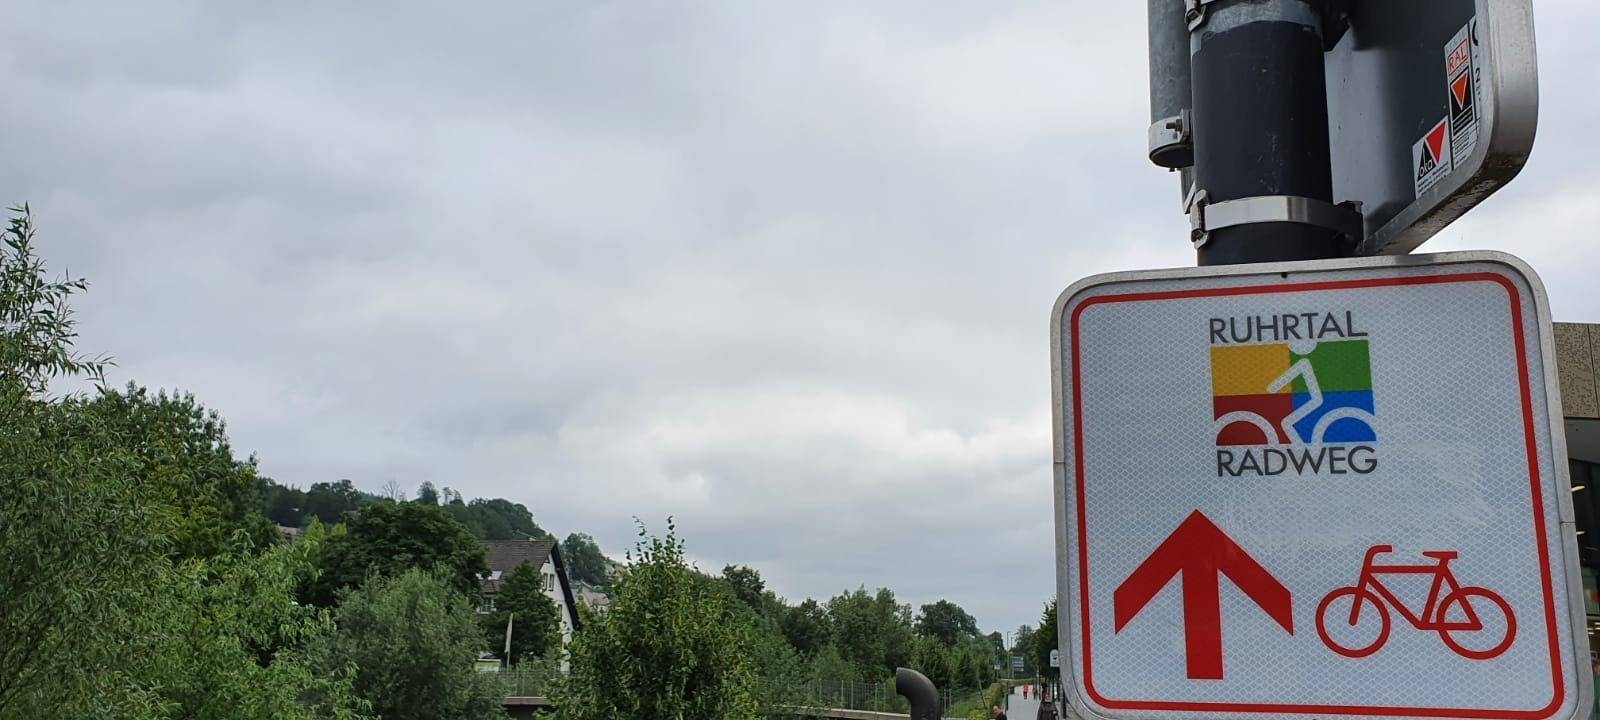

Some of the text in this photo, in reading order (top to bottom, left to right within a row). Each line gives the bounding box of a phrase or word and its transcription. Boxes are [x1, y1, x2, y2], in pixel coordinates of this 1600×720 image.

[1448, 45, 1467, 72] RAL
[1209, 311, 1368, 344] RUHRTAL
[1216, 446, 1377, 477] RADWEG
